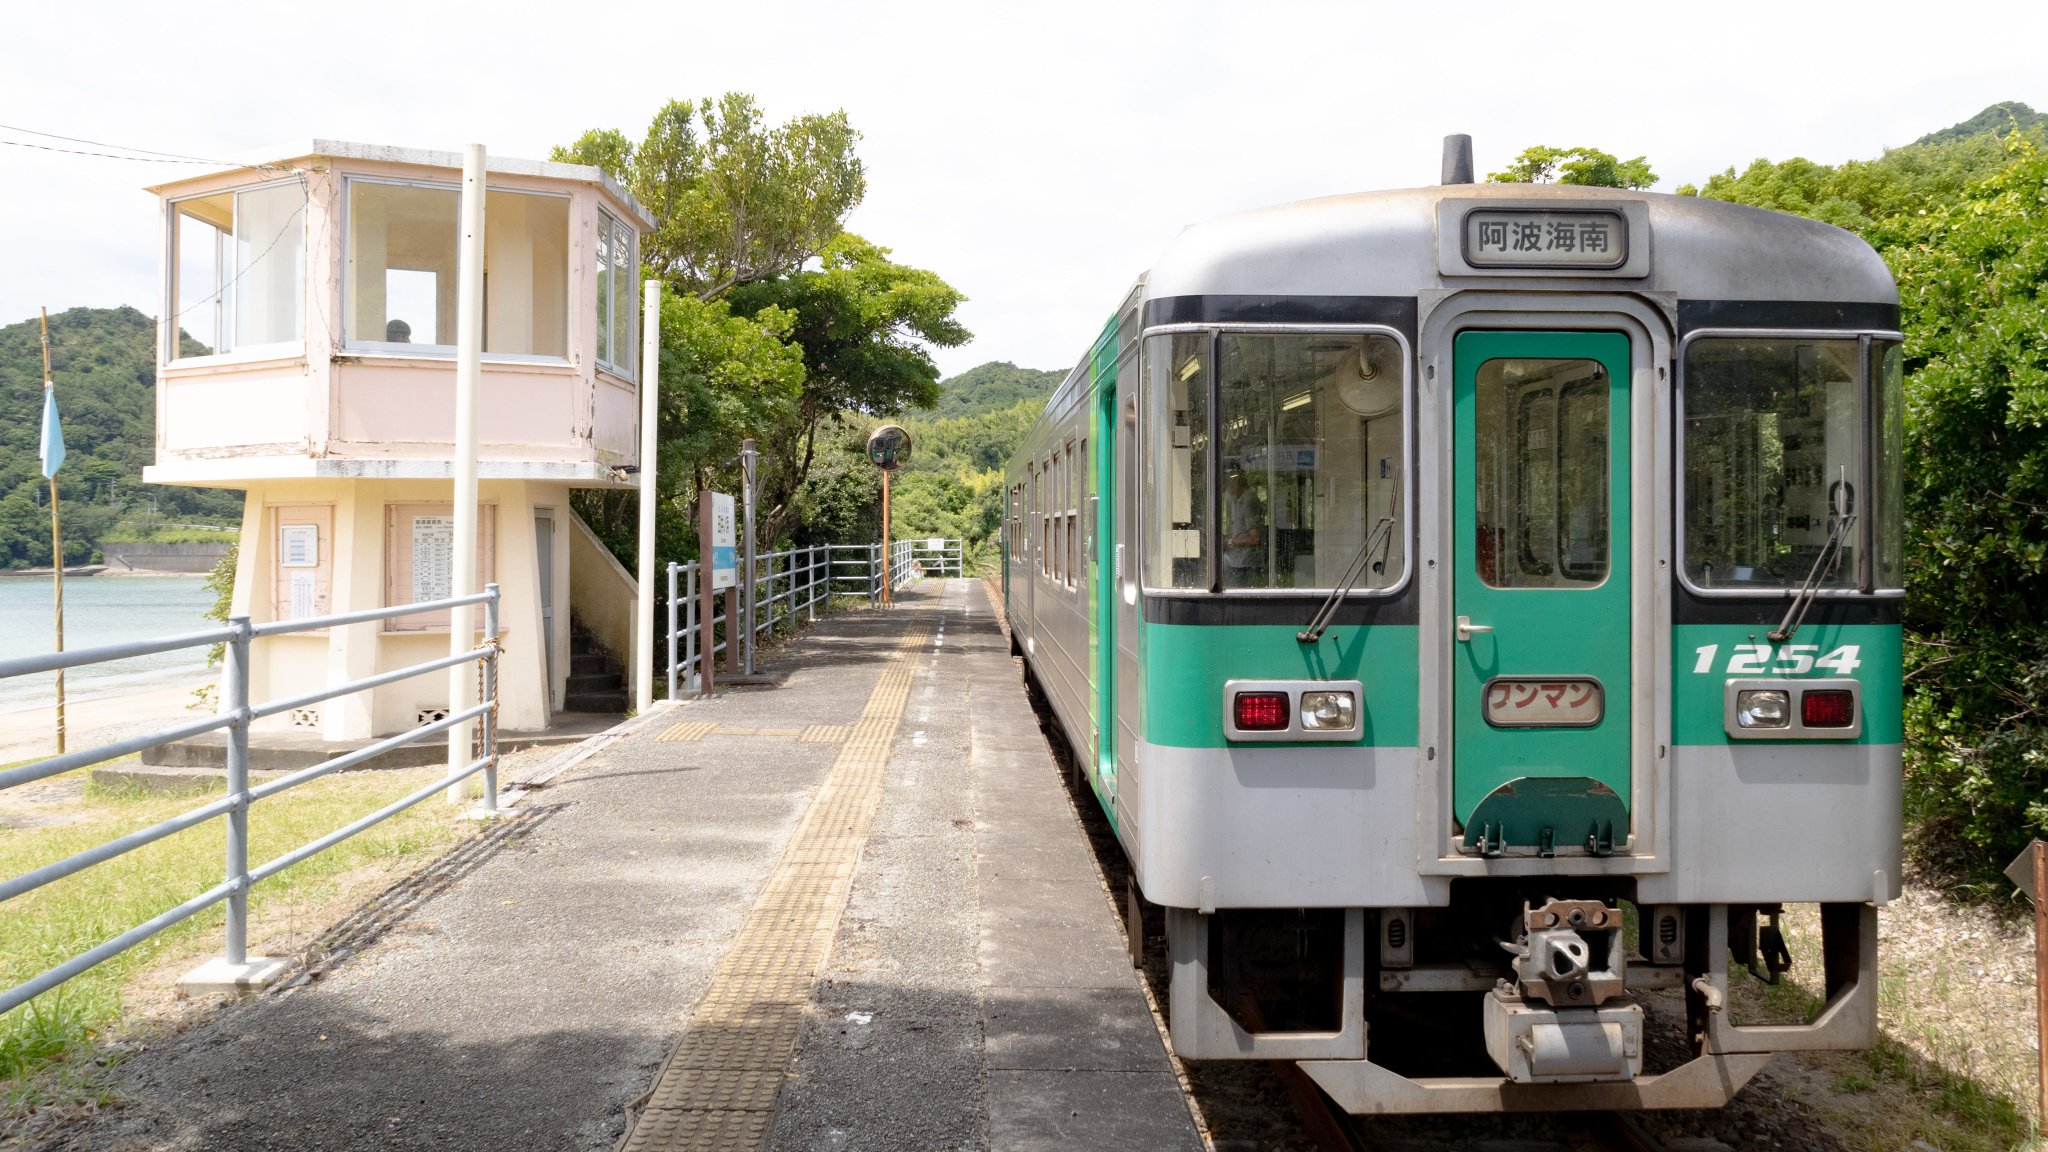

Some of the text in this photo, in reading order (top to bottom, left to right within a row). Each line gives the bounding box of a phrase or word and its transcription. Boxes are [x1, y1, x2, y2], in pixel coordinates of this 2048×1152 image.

[1479, 221, 1609, 253] 阿波海南
[1692, 644, 1862, 675] 1254
[1489, 683, 1593, 710] ワンマン
